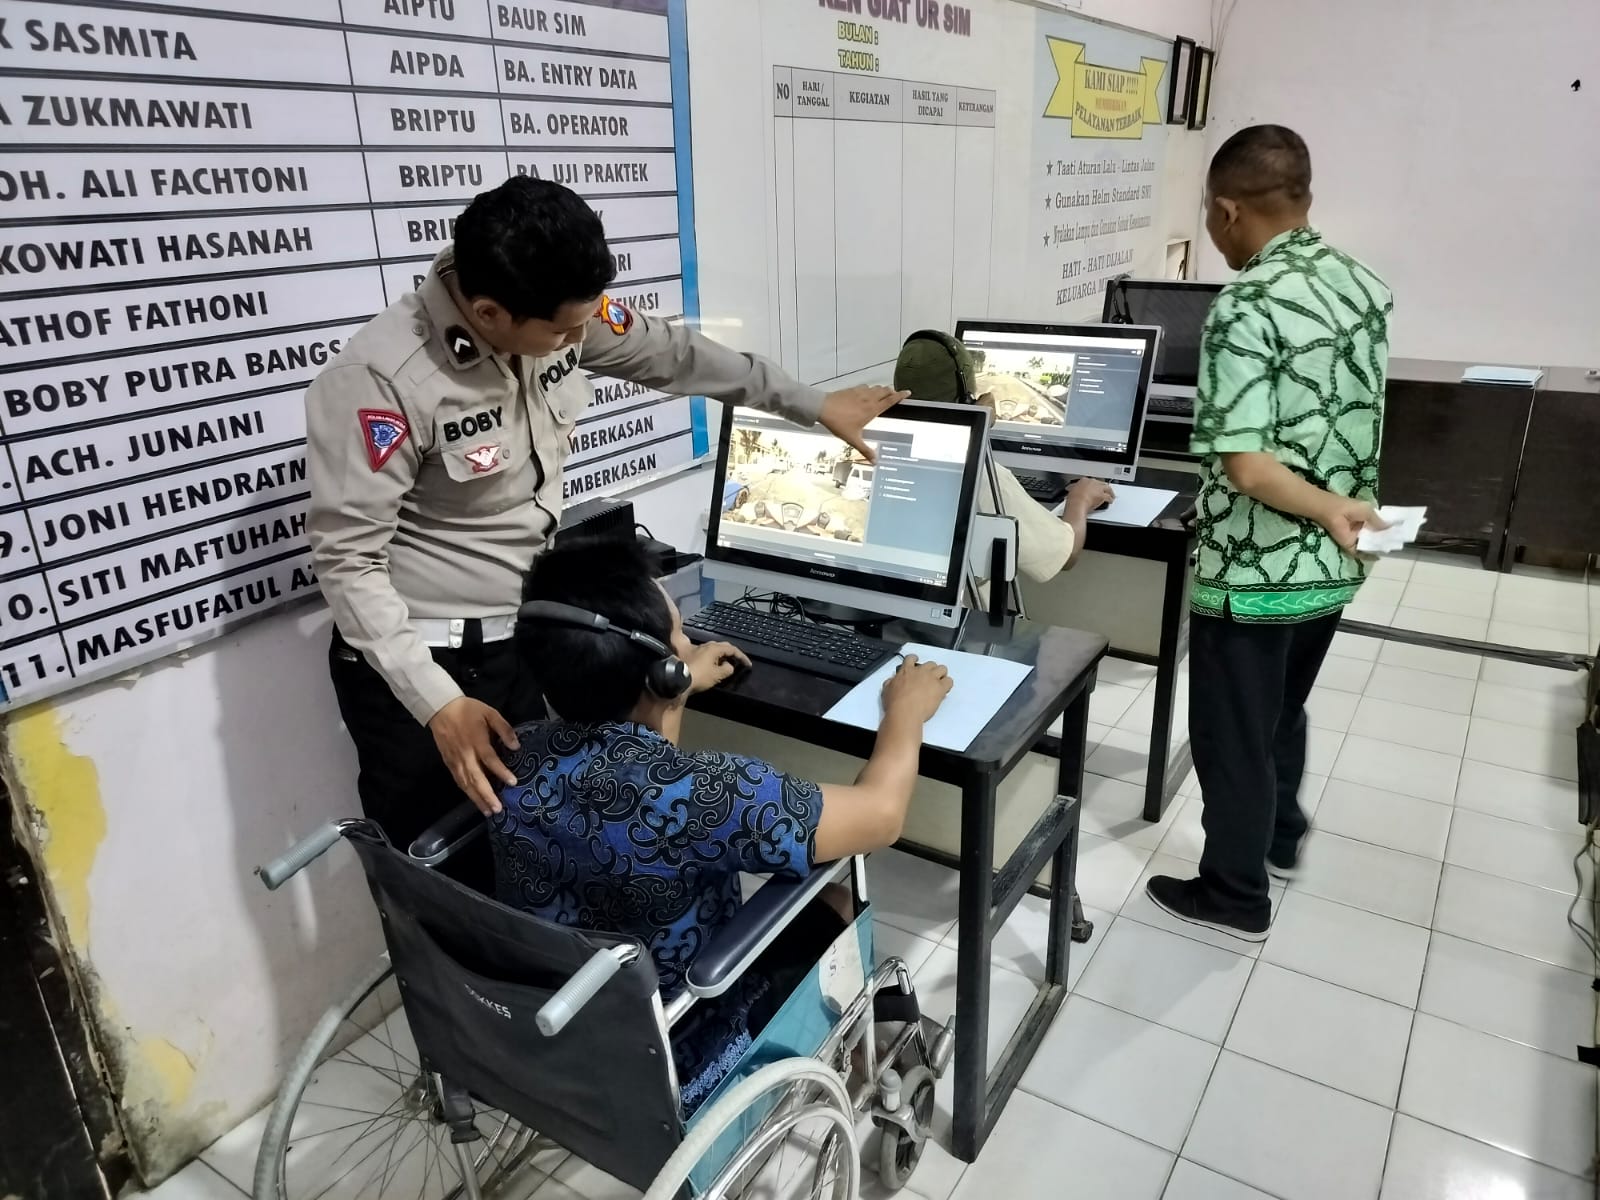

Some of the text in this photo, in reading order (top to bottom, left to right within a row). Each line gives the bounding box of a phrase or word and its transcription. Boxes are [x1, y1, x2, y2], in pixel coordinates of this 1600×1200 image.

[384, 0, 586, 37] AIPTU BAUR SIM
[915, 0, 940, 30] UR
[943, 4, 971, 37] SIM
[838, 20, 873, 44] BULAN
[25, 19, 197, 61] SASMITA
[390, 50, 464, 78] AIPDA
[504, 59, 535, 83] BA.
[541, 62, 593, 87] ENTRY
[599, 68, 637, 91] DATA
[838, 49, 874, 71] TAHUN
[776, 83, 790, 100] NO
[802, 81, 820, 92] HARI
[1085, 69, 1106, 91] KAMI
[1107, 72, 1125, 93] SIAP
[797, 95, 830, 107] TANGGAL
[849, 91, 890, 106] KEGIATAN
[912, 90, 949, 103] HASIL YANG
[958, 102, 994, 113] KETERANGAN
[22, 95, 252, 129] ZUKMAWATI
[390, 108, 476, 133] BRIPTU
[510, 112, 541, 135] BA.
[547, 114, 629, 137] OPERATOR
[918, 105, 943, 117] DICAPAI
[1057, 160, 1076, 175] Taati
[1078, 160, 1101, 175] Aturan
[82, 169, 138, 199] ALI
[150, 166, 309, 196] FACHTONI
[399, 164, 483, 187] BRIPTU
[552, 163, 579, 184] UJI
[584, 163, 649, 183] PRAKTEK
[1055, 190, 1090, 209] Gunakan
[1092, 188, 1110, 205] Helm
[1112, 186, 1140, 202] Standard
[157, 227, 313, 262] HASANAH
[1062, 261, 1082, 279] HATI
[1087, 255, 1105, 273] HATI
[1056, 280, 1096, 305] KELUARGA
[125, 291, 269, 331] FATHONI
[4, 338, 351, 418] BOBY PUTRA BANGS
[443, 406, 504, 442] BOBY
[26, 443, 114, 484] ACH.
[128, 410, 265, 463] JUNAINI
[43, 502, 131, 547] JONI
[0, 594, 48, 627] 0.
[58, 565, 127, 607] SITI
[140, 512, 307, 583] MAFTUHAH
[2, 654, 66, 688] 11.
[77, 576, 282, 665] MASFUFATUL
